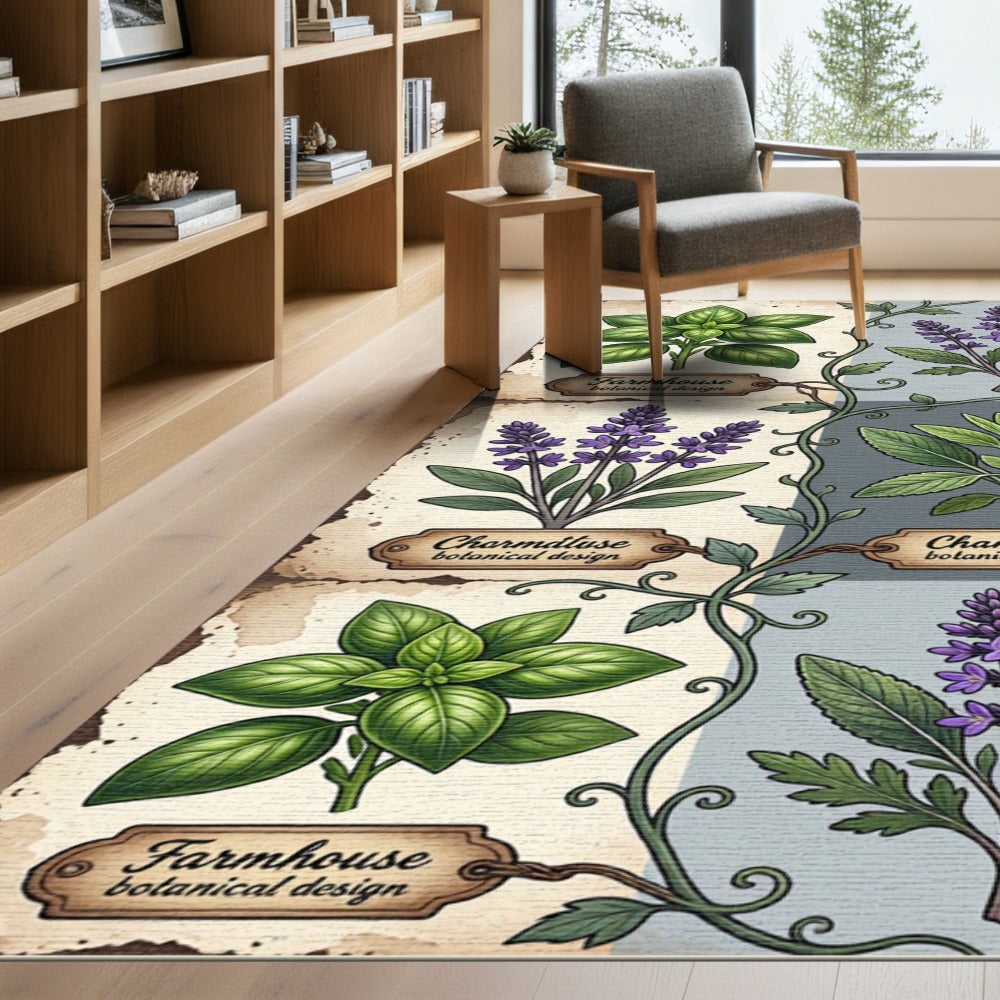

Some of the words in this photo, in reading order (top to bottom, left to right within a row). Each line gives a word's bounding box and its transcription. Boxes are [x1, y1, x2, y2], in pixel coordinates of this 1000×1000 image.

[431, 550, 547, 561] botanical
[547, 550, 621, 564] design
[121, 838, 433, 874] Farmhouse
[103, 874, 289, 898] botanical
[289, 874, 409, 906] design
